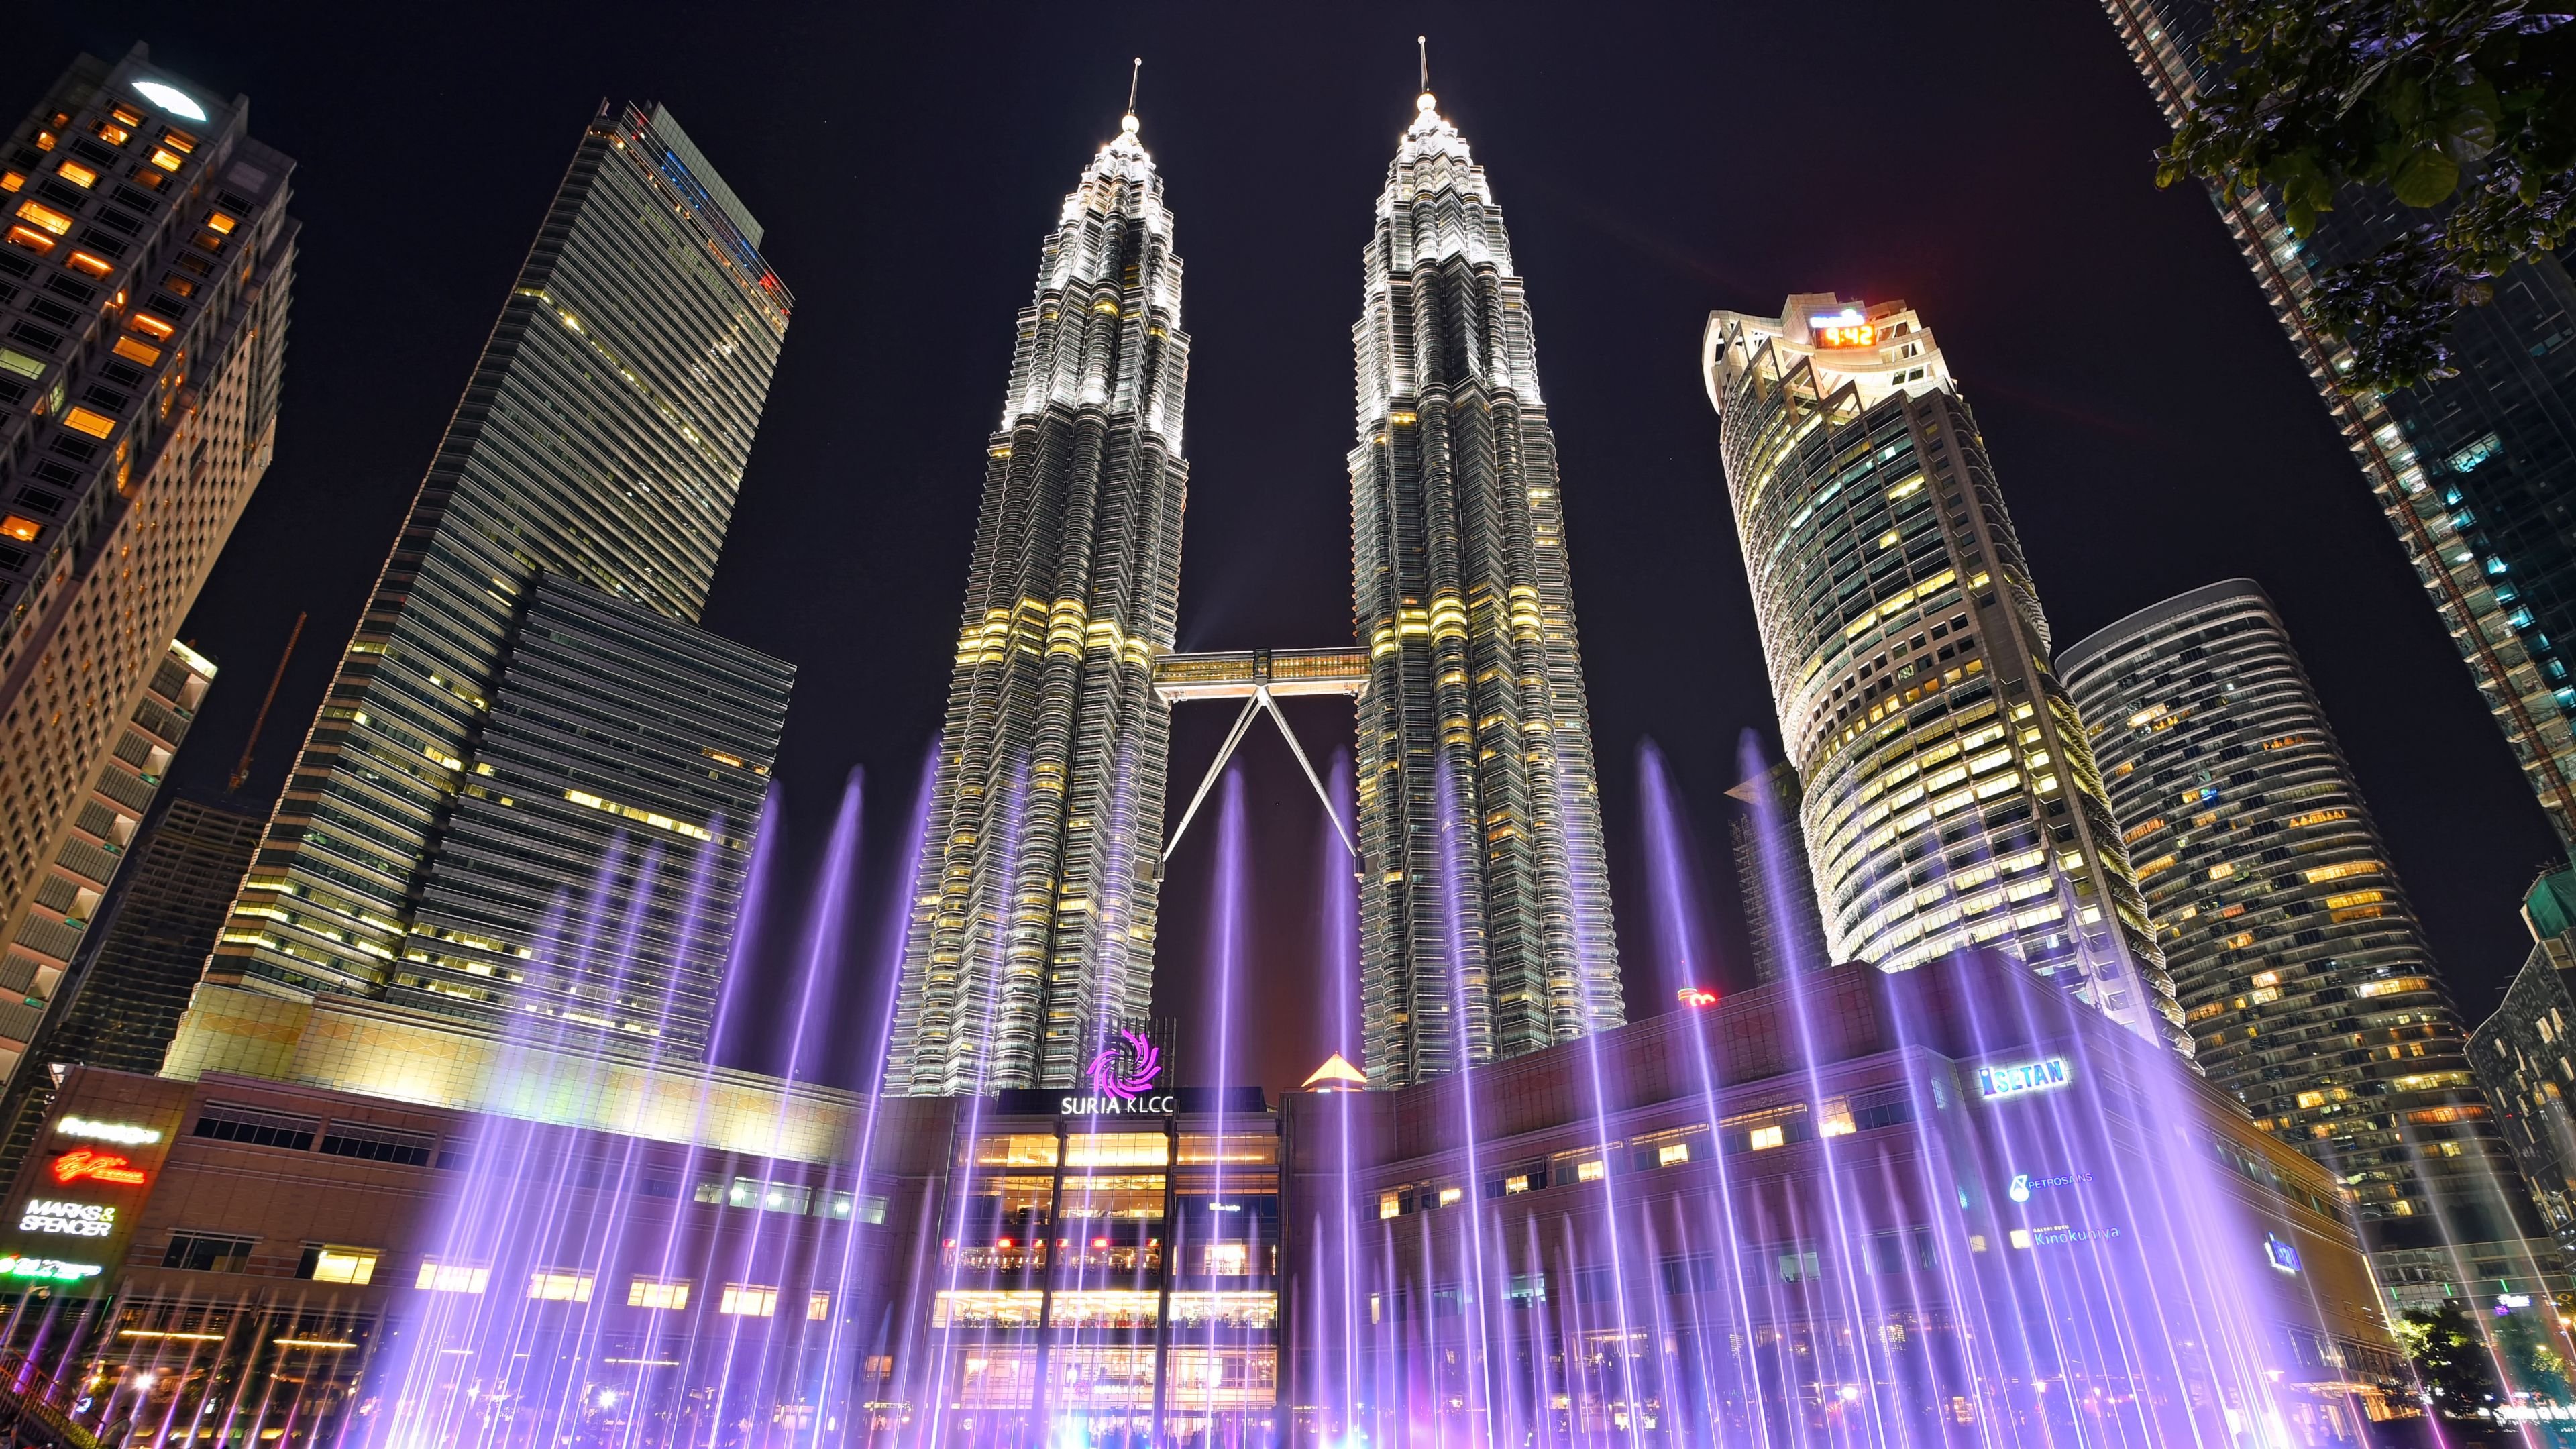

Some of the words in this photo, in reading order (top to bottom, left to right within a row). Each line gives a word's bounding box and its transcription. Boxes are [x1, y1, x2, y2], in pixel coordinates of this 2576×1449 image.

[1826, 326, 1872, 345] 9:42
[1061, 1097, 1120, 1115] SURIA
[1127, 1096, 1174, 1113] KLCC
[2029, 1173, 2093, 1189] PETROSAINS
[19, 1215, 113, 1236] SPENCER
[2034, 1227, 2120, 1246] Kinokuniya
